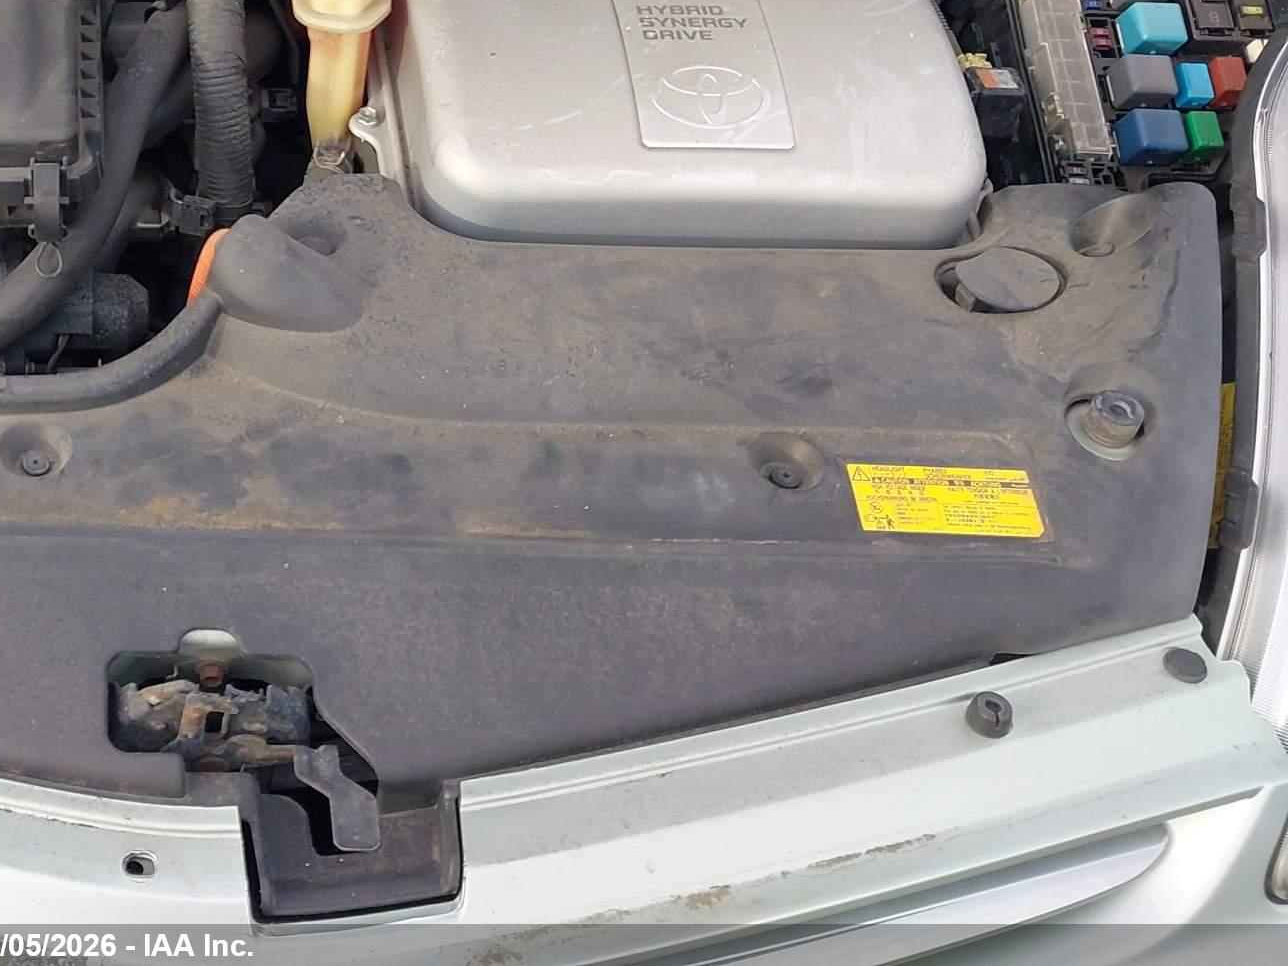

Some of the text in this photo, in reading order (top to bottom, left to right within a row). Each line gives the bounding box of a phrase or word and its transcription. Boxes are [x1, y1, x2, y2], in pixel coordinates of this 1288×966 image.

[635, 4, 725, 16] HYBRID
[639, 17, 748, 29] SYNERGY
[642, 29, 715, 41] DRIVE
